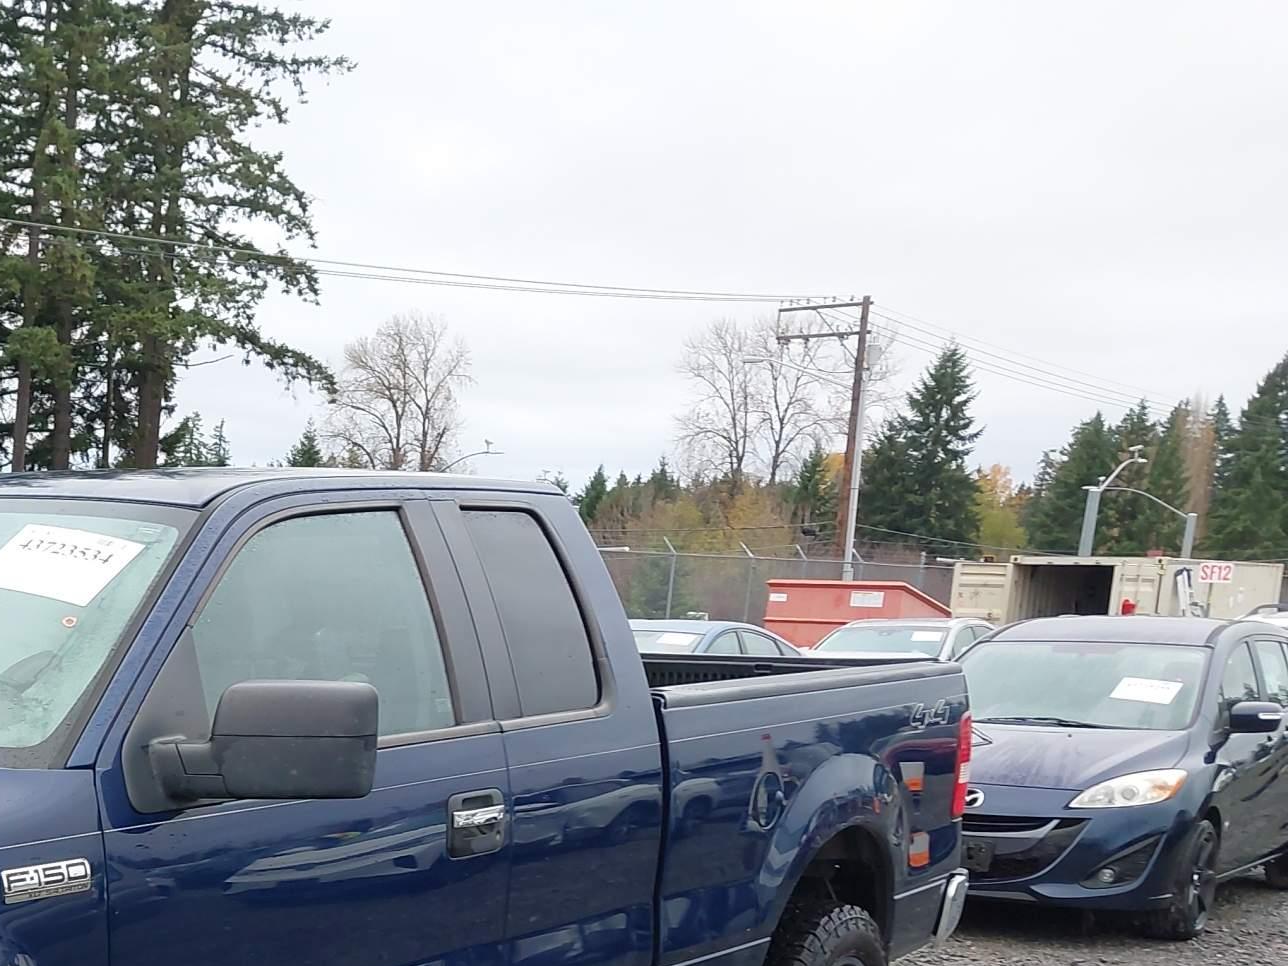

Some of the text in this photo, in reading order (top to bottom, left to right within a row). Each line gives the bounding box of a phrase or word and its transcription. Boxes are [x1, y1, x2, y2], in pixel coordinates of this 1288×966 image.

[19, 538, 114, 564] 43723534
[1200, 564, 1232, 581] SF12
[3, 859, 90, 893] F-150
